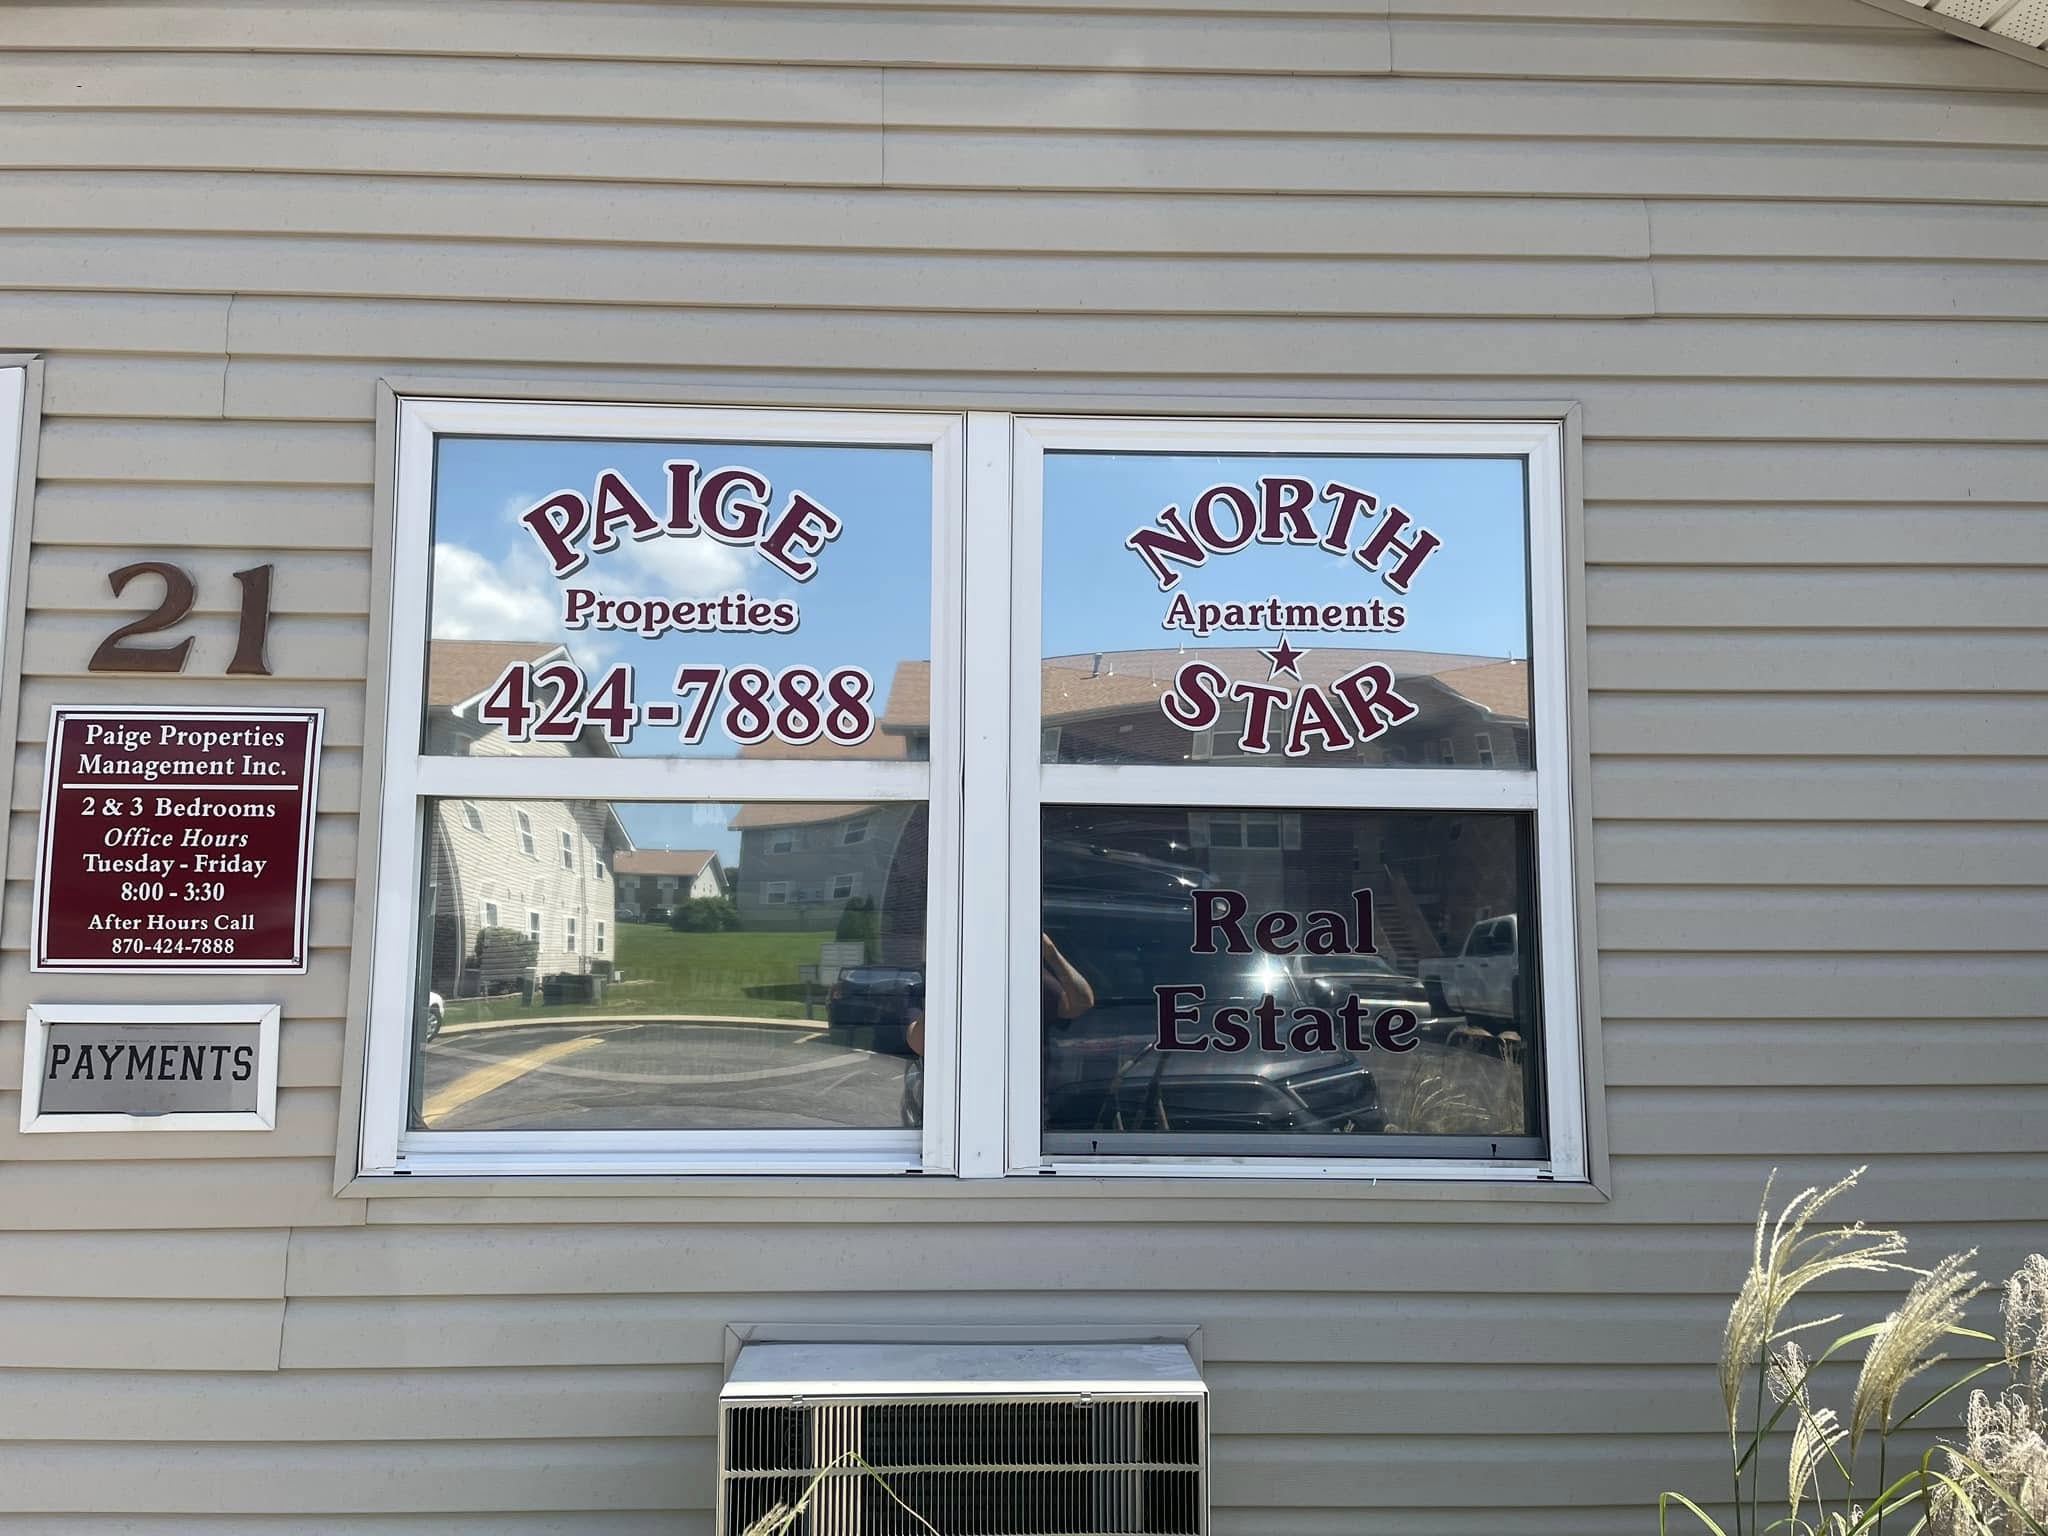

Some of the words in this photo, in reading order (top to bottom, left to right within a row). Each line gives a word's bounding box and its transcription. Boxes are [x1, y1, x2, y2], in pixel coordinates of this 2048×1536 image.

[521, 461, 841, 578] PAIGE
[1127, 476, 1441, 592] NORTH
[88, 561, 274, 676] 21
[565, 588, 797, 635] Properties
[1165, 593, 1406, 633] Apartments
[481, 663, 872, 743] 424-7888
[1161, 661, 1418, 756] STAR
[85, 724, 151, 751] Paige
[159, 725, 285, 752] Properties
[77, 754, 234, 781] Management
[241, 755, 287, 776] Inc.
[81, 797, 95, 816] 2
[102, 797, 123, 816] &
[129, 797, 144, 817] 3
[154, 797, 276, 817] Bedrooms
[104, 828, 173, 847] Office
[181, 828, 249, 847] Hours
[83, 853, 174, 878] Tuesday
[193, 854, 267, 878] Friday
[120, 882, 163, 901] 8:00
[184, 883, 225, 901] 3:30
[88, 914, 142, 930] After
[147, 914, 208, 930] Hours
[214, 914, 255, 930] Call
[1190, 888, 1379, 955] Real
[111, 938, 235, 954] 870-424-7888
[1153, 984, 1420, 1054] Estate
[49, 1044, 253, 1081] PAYMENTS
